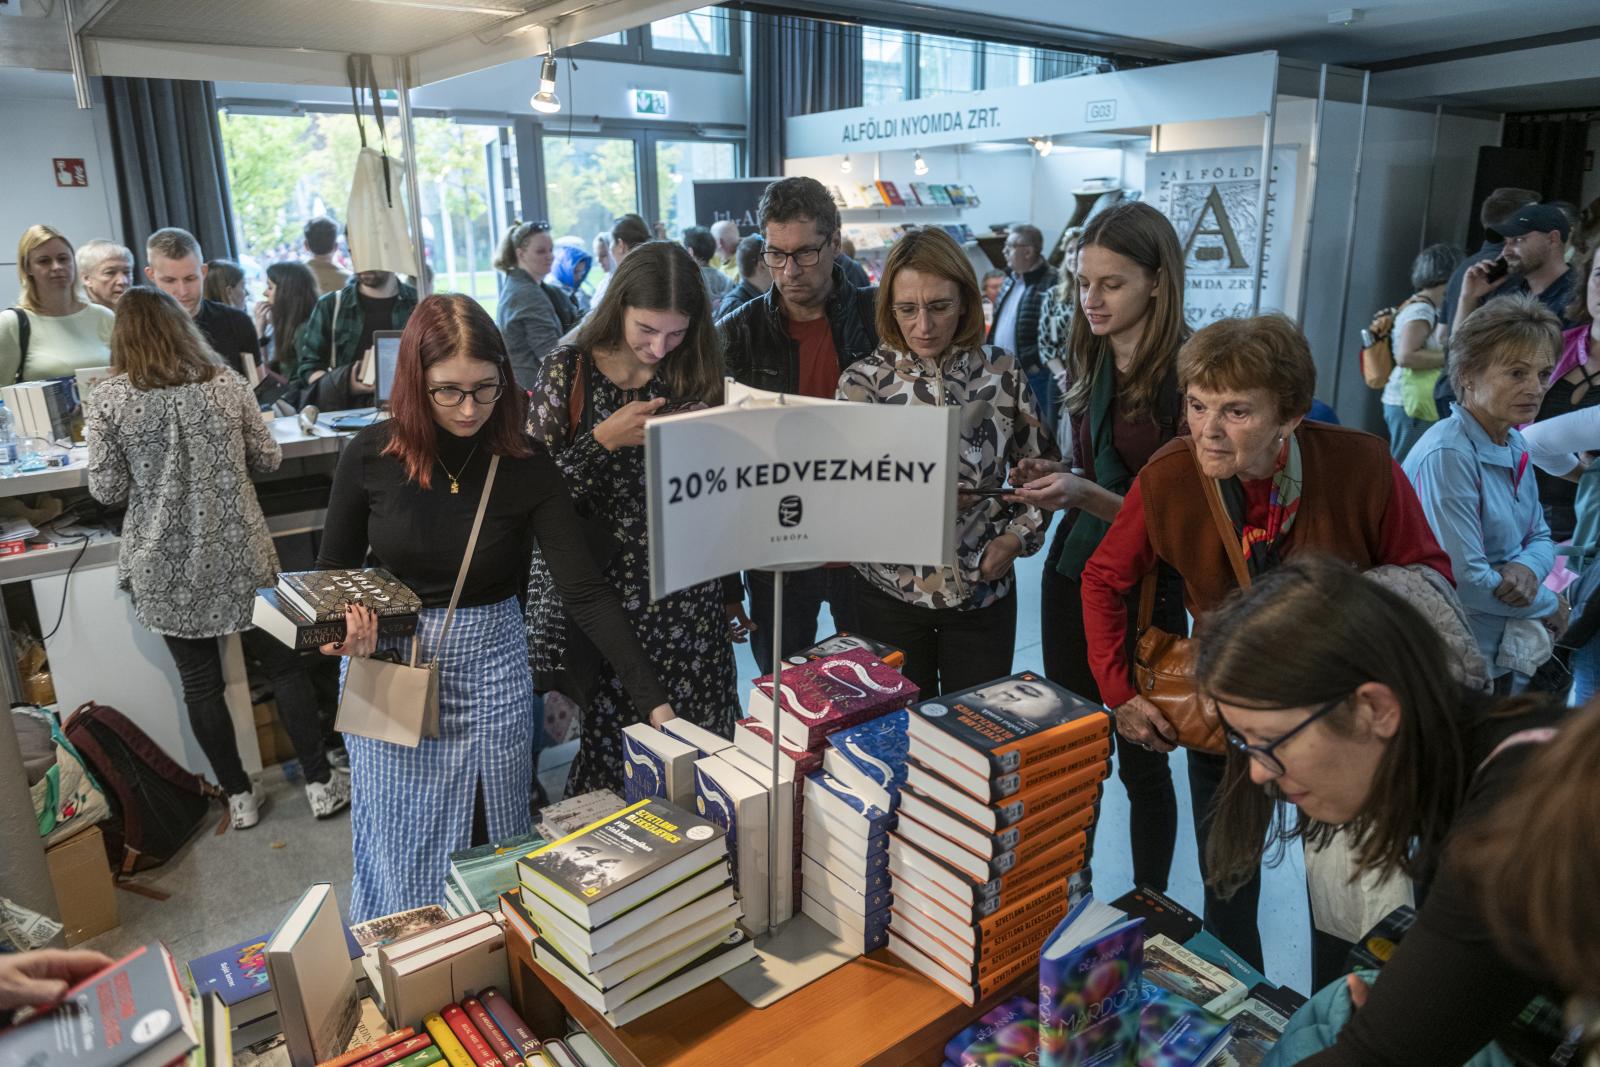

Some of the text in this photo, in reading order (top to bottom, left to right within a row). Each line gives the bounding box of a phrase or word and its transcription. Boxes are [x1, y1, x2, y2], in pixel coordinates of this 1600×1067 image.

[842, 107, 1000, 142] ALFÖLDI NYOMDA ZRT.
[1170, 166, 1255, 181] ALFÖLD
[1185, 279, 1223, 290] OMDA
[668, 453, 937, 504] 20% KEDVEZMÉNY
[770, 533, 809, 543] EURÓPA
[302, 632, 342, 645] MARTIN
